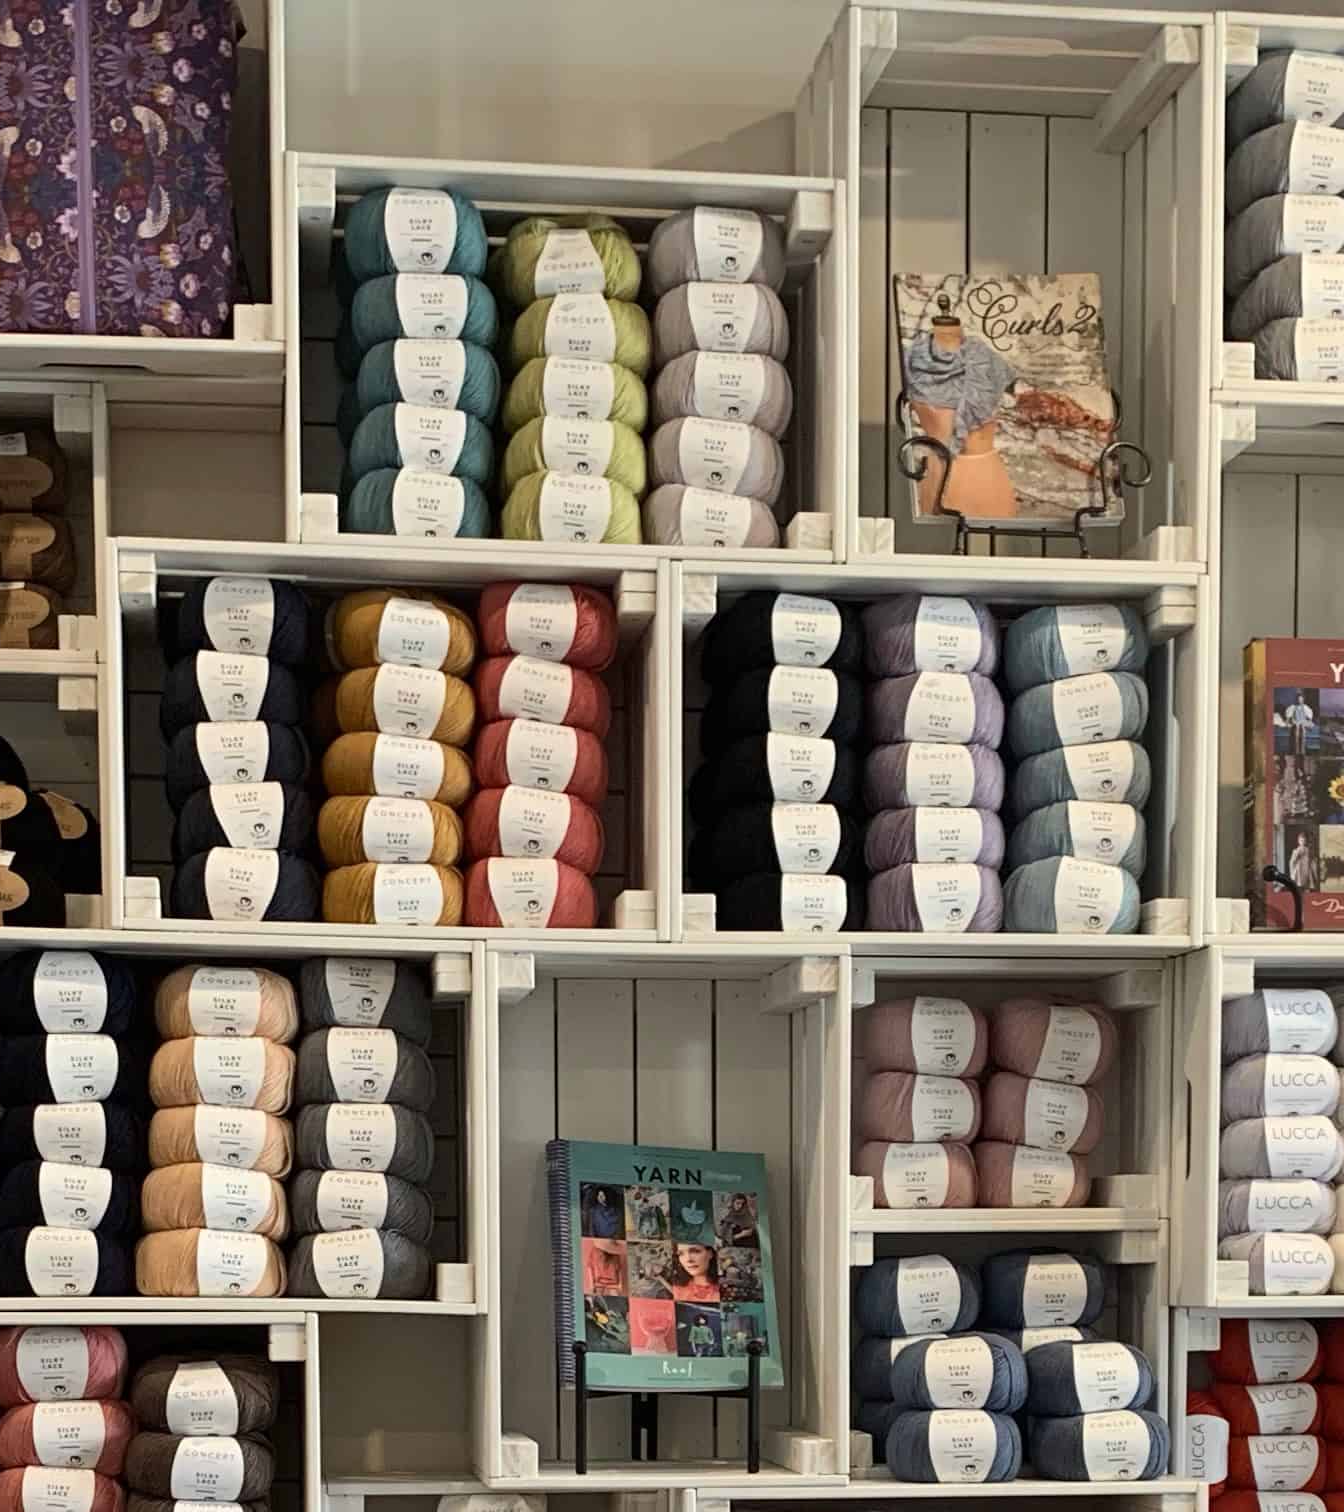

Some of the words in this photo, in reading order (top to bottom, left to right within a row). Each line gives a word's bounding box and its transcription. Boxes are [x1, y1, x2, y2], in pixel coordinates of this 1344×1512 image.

[967, 281, 1064, 352] Curls
[1271, 1002, 1325, 1016] LUCCA
[633, 1165, 703, 1186] YARN
[1256, 1330, 1310, 1344] LUCCA
[1192, 1424, 1206, 1478] LUCCA
